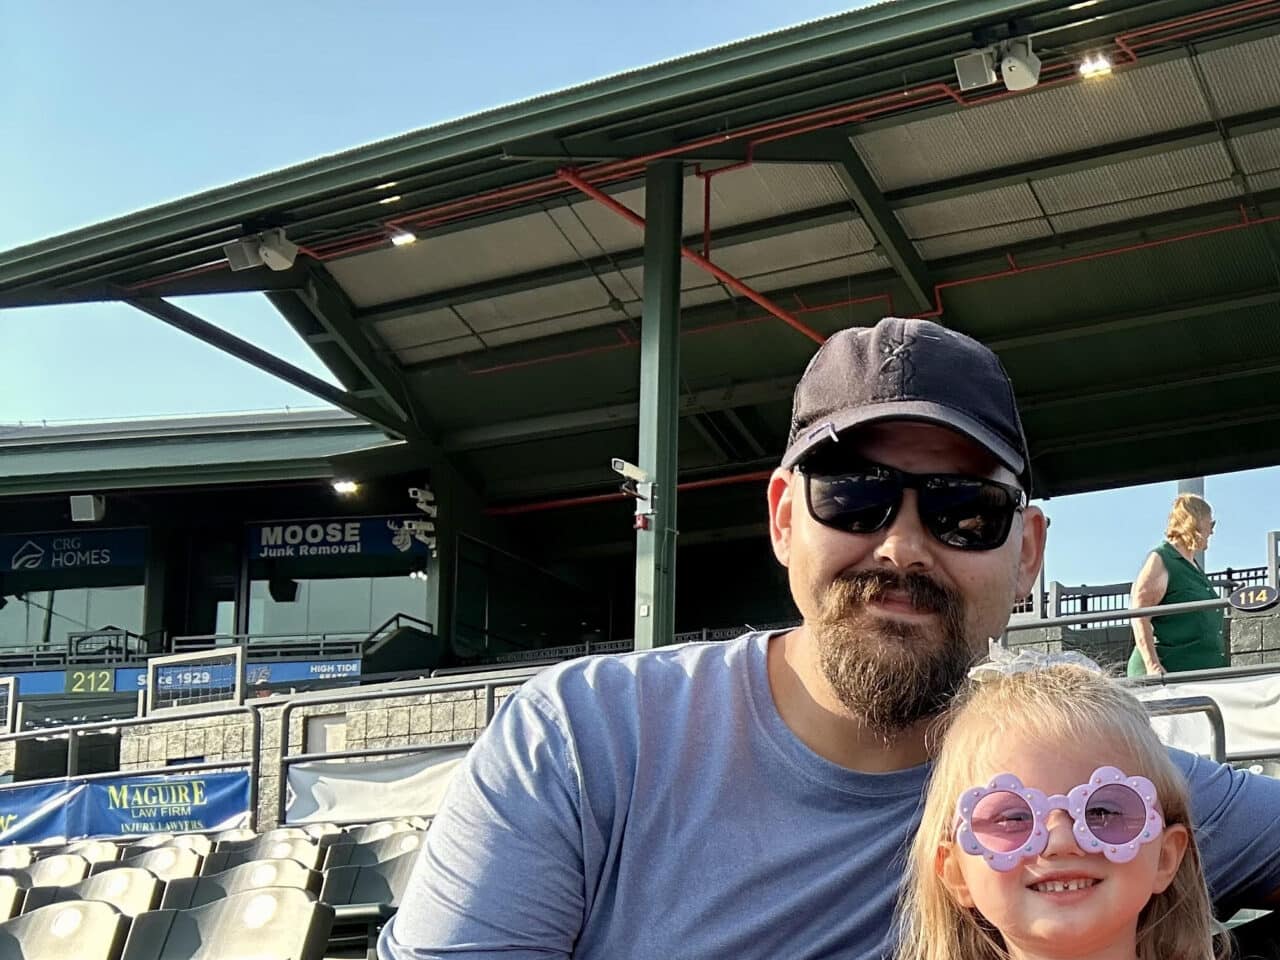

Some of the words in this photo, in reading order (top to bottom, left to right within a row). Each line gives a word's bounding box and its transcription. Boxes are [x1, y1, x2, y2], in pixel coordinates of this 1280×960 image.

[261, 523, 361, 546] MOOSE
[52, 537, 81, 551] CRG
[260, 546, 295, 557] Junk
[300, 542, 361, 556] Removal
[51, 549, 111, 568] HOMES
[1239, 589, 1268, 605] 114
[310, 664, 334, 673] HIGH
[336, 663, 358, 672] TIDE
[71, 671, 111, 692] 212
[137, 674, 172, 686] Sce
[176, 671, 210, 684] 1929
[107, 780, 208, 810] MAGUIRE
[131, 808, 157, 819] LAW
[161, 806, 192, 818] FIRM
